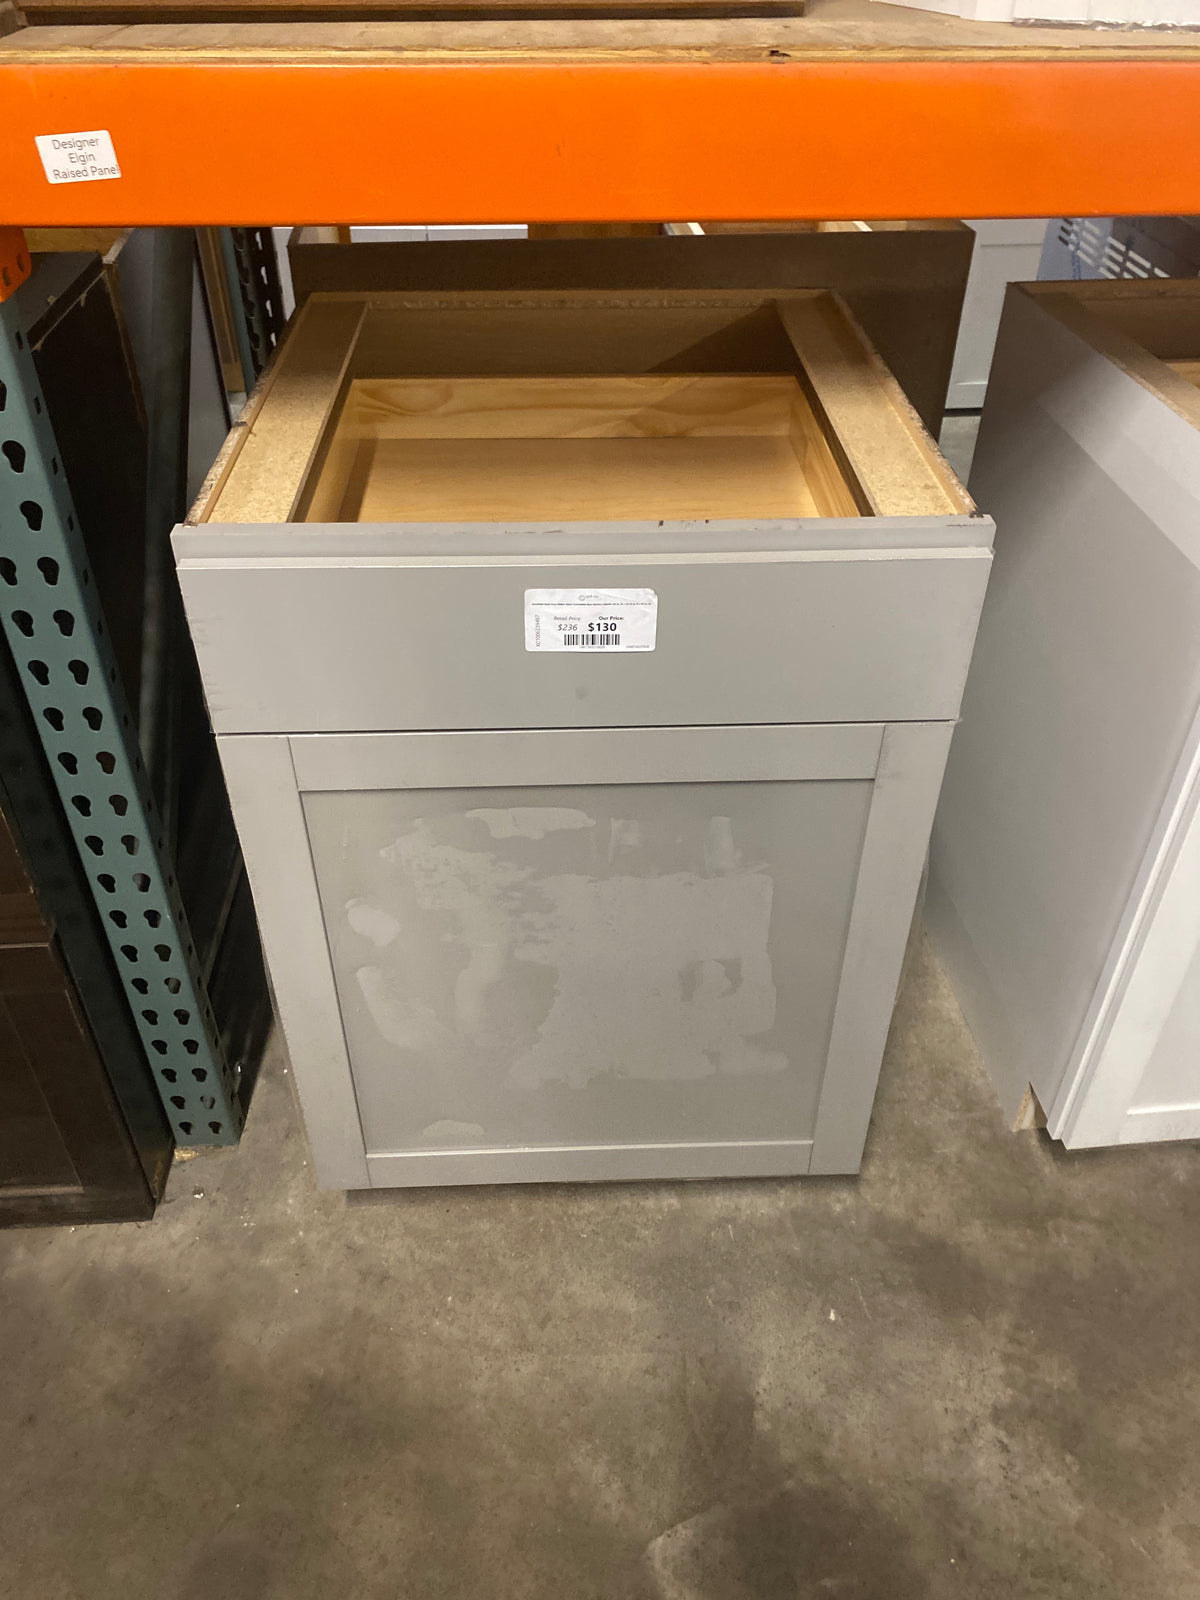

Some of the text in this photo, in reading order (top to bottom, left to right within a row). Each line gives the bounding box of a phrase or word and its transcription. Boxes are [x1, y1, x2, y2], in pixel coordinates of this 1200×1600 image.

[52, 138, 99, 150] Designer
[68, 151, 96, 165] Elgin
[53, 168, 89, 179] Raised
[557, 623, 578, 632] $236
[587, 622, 617, 632] $130
